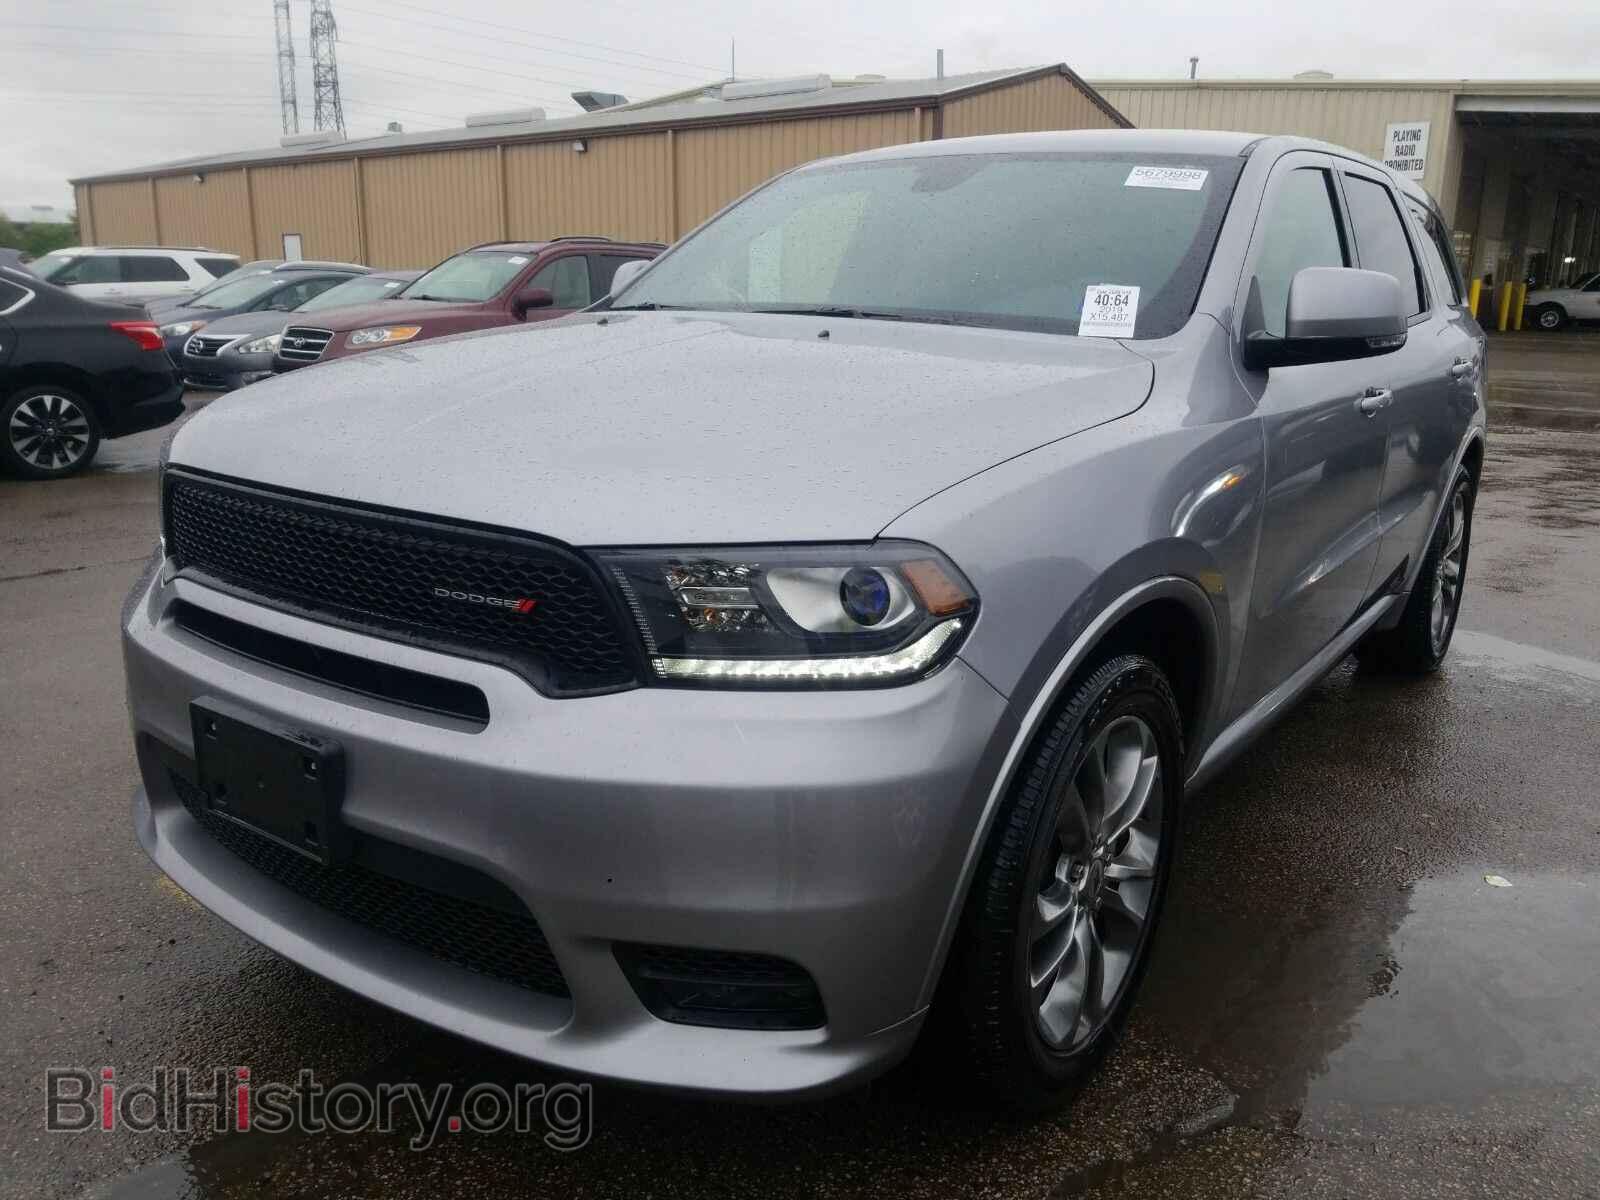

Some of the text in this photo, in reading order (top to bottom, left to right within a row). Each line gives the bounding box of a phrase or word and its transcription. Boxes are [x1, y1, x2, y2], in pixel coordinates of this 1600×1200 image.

[1393, 129, 1421, 141] PLAYING
[1395, 144, 1415, 157] RADIO
[1135, 168, 1202, 180] 5679998
[1094, 294, 1129, 307] 40:64
[1100, 305, 1123, 313] 2019
[434, 587, 520, 609] DODGE
